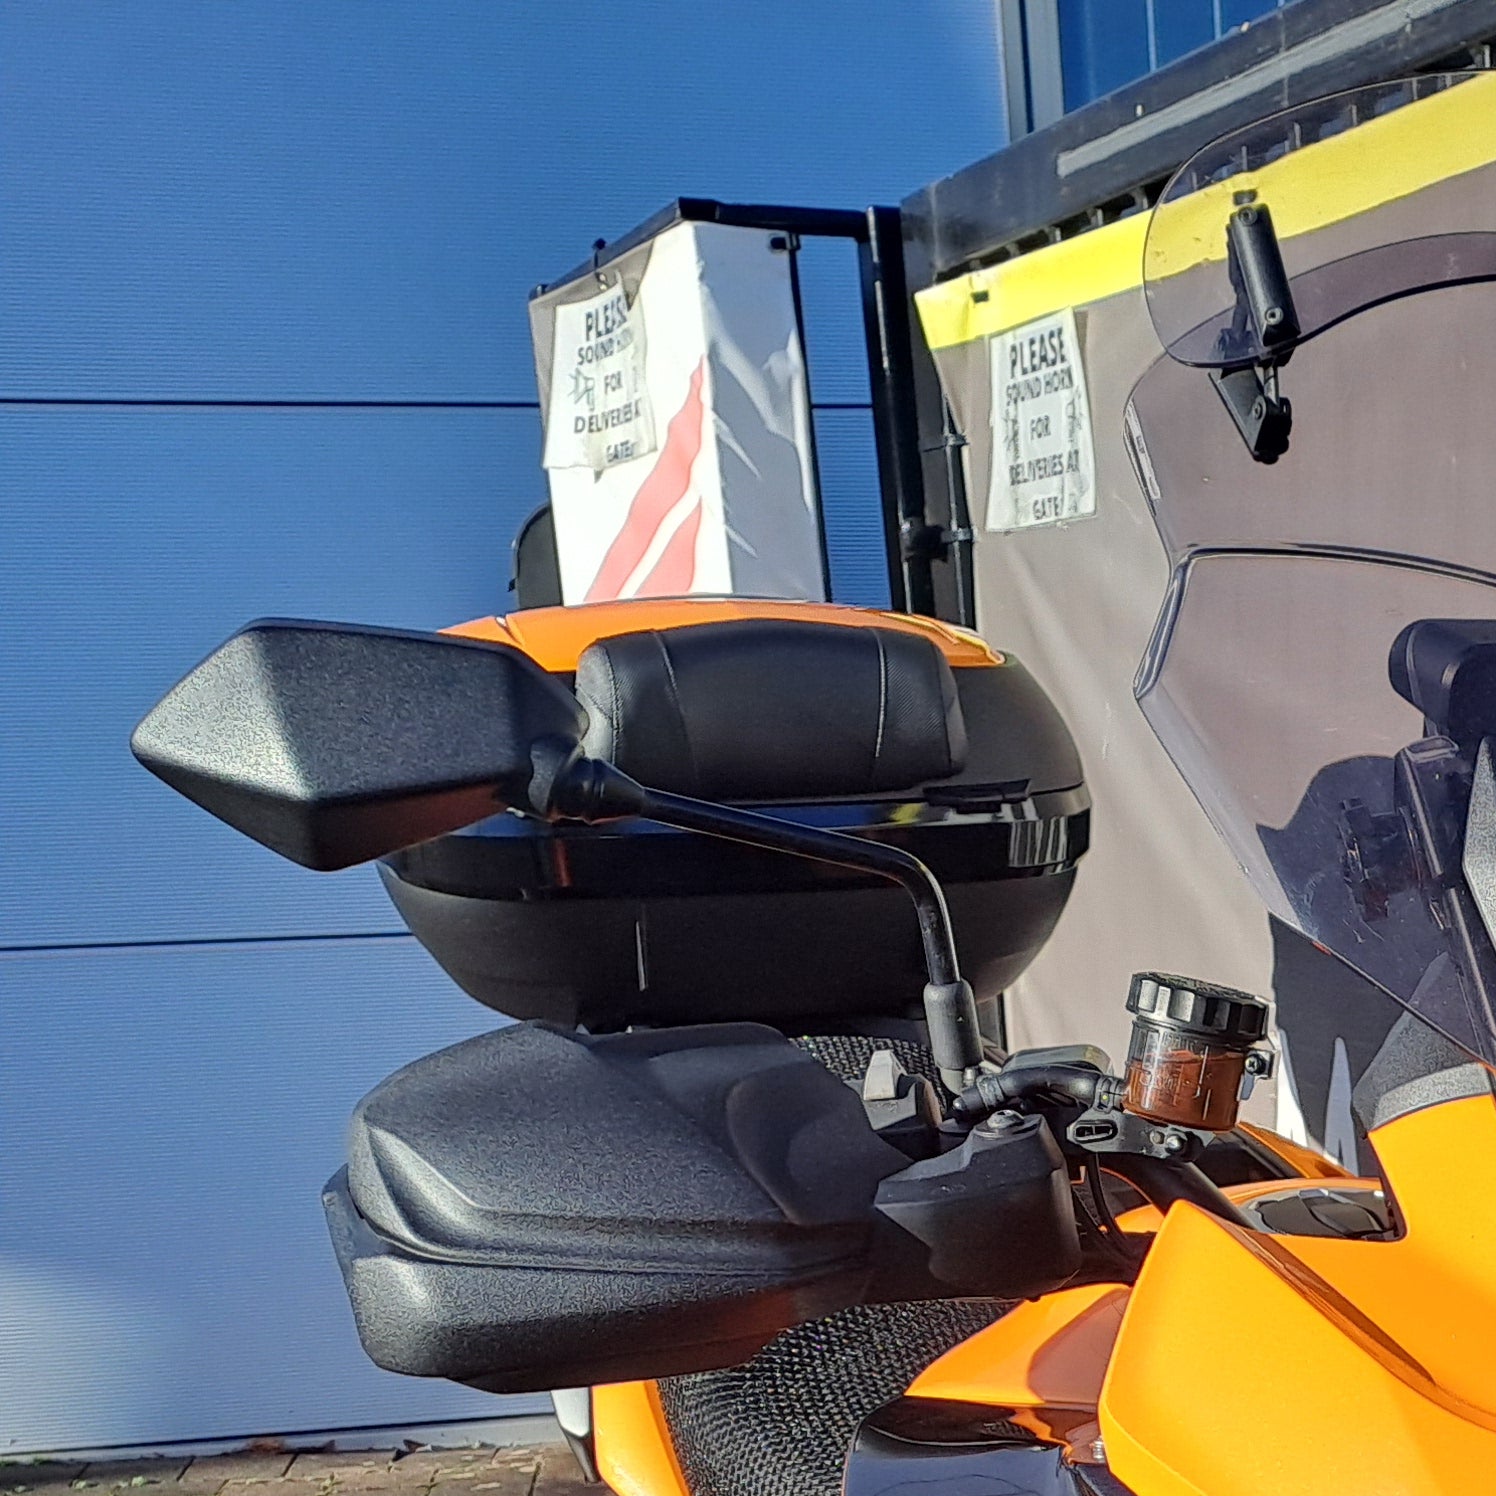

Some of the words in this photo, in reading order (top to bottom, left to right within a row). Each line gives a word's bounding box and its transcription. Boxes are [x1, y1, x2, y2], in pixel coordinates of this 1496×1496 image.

[1009, 326, 1068, 379] PLEASE
[604, 371, 623, 395] FOR
[1006, 376, 1042, 407] SOUND
[1029, 415, 1052, 441] FOR
